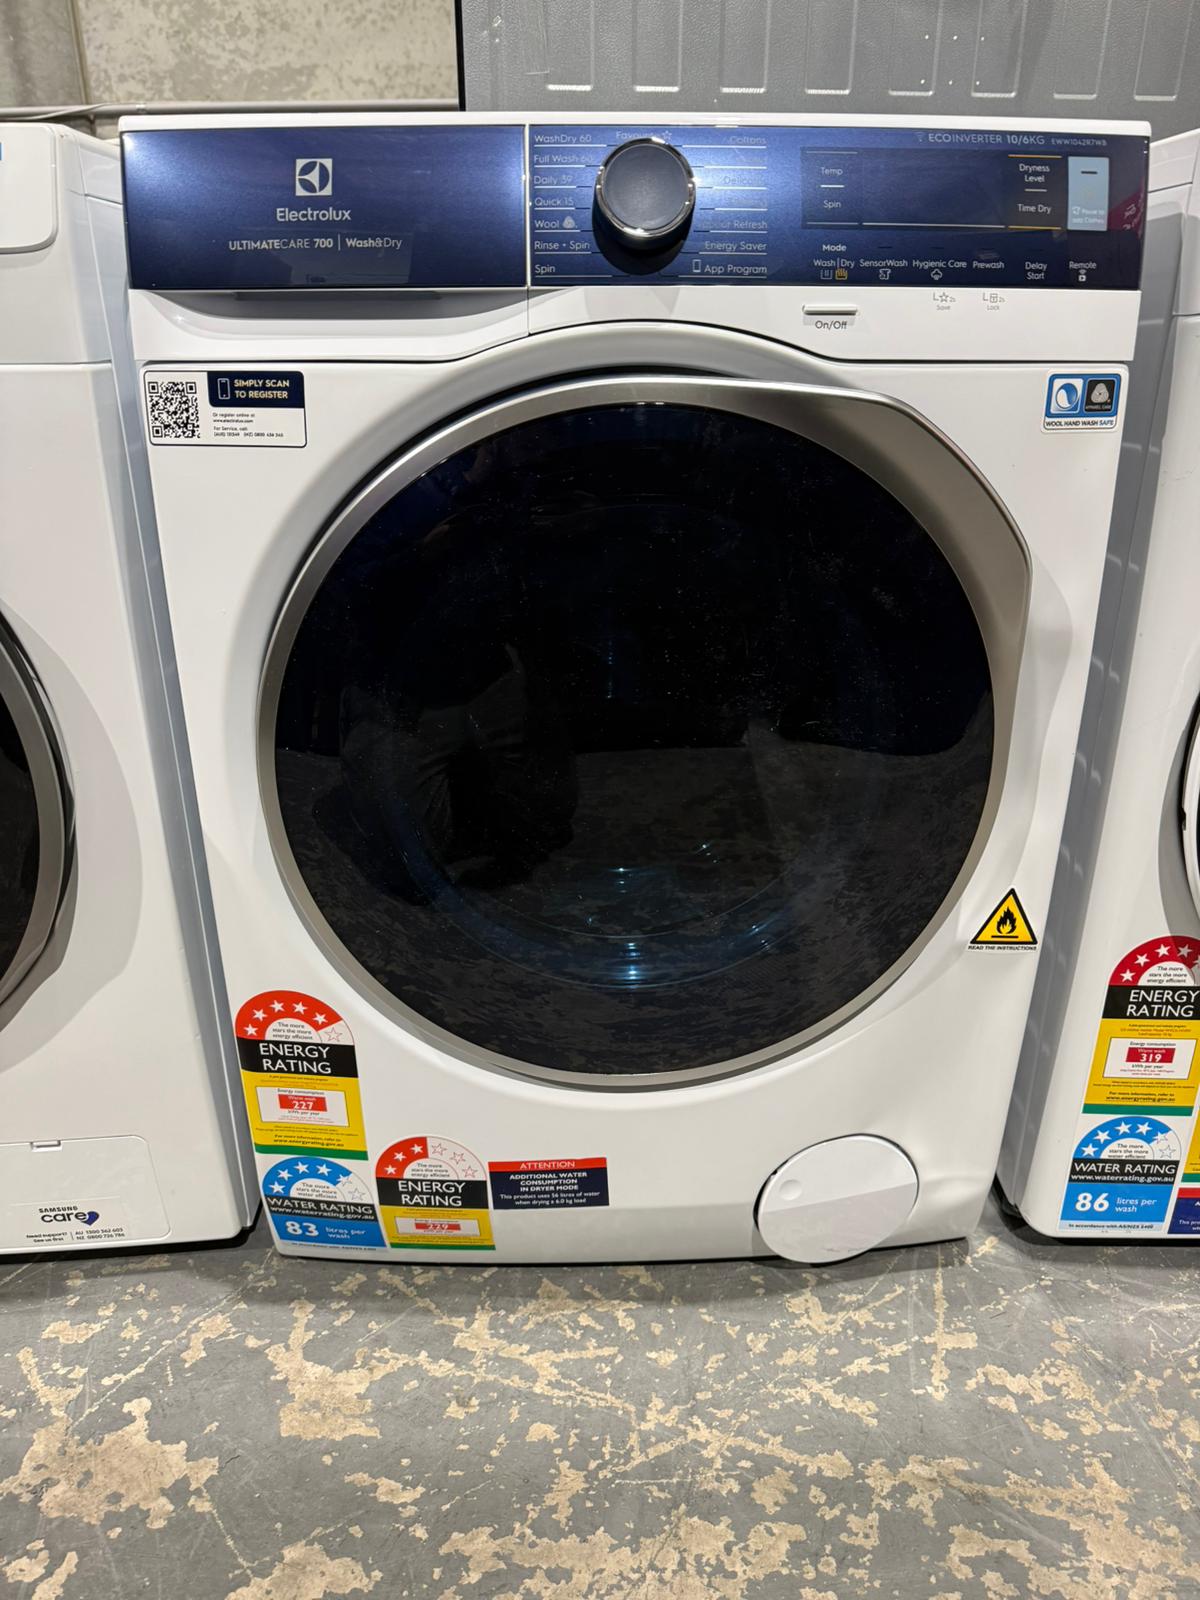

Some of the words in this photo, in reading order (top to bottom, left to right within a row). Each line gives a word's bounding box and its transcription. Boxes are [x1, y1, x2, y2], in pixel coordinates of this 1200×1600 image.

[534, 135, 578, 145] WashDry
[579, 135, 592, 143] 60
[928, 133, 1002, 144] ECOINVERTER
[1006, 134, 1045, 145] 10/6KG
[534, 154, 550, 163] Full
[552, 154, 574, 163] Wash
[820, 167, 843, 177] Temp
[1019, 163, 1050, 173] Dryness
[534, 175, 557, 185] Daily
[1024, 173, 1045, 183] Level
[534, 197, 562, 206] Quick
[564, 198, 574, 206] 15
[823, 200, 841, 210] Spin
[276, 207, 351, 222] Electrolux
[1018, 204, 1032, 213] Time
[1034, 204, 1052, 215] Dry
[534, 220, 559, 228] Wool
[734, 220, 768, 229] Refresh
[229, 239, 310, 251] ULTIMATECARE
[313, 237, 333, 249] 700
[346, 237, 402, 250] Wash&Dry
[534, 241, 559, 250] Rinse
[569, 241, 590, 251] Spin
[705, 241, 738, 251] Energy
[740, 241, 767, 251] Saver
[822, 243, 847, 252] Mode
[813, 259, 836, 268] Wash
[840, 259, 855, 269] Dry
[859, 259, 908, 268] SensorWash
[912, 259, 946, 270] Hygienic
[947, 260, 967, 269] Care
[973, 260, 1005, 270] Prewash
[1025, 261, 1047, 272] Delay
[1069, 261, 1097, 270] Remote
[535, 264, 555, 274] Spin
[704, 264, 725, 275] App
[727, 264, 767, 275] Program
[1026, 272, 1045, 281] Start
[814, 320, 847, 330] On/Off
[234, 379, 264, 388] SIMPLY
[265, 379, 289, 388] SCAN
[235, 390, 246, 398] TO
[249, 390, 288, 399] REGISTER
[1129, 989, 1200, 1003] ENERGY
[1126, 1004, 1195, 1017] RATING
[259, 1042, 330, 1059] ENERGY
[1140, 1053, 1162, 1063] 319
[262, 1058, 332, 1074] RATING
[292, 1101, 314, 1110] 227
[520, 1161, 575, 1170] ATTENTION
[1074, 1162, 1120, 1173] WATER
[1124, 1164, 1176, 1175] RATING
[1071, 1174, 1174, 1183] www.waterrating.gov.au
[397, 1181, 466, 1194] ENERGY
[267, 1197, 317, 1210] WATER
[320, 1202, 373, 1214] RATING
[401, 1194, 462, 1207] RATING
[1075, 1192, 1110, 1212] 86
[1116, 1197, 1139, 1205] litres
[270, 1207, 375, 1220] www.waterrating.gov.au
[1115, 1205, 1137, 1213] wash
[41, 1212, 87, 1223] care
[285, 1221, 319, 1237] 83
